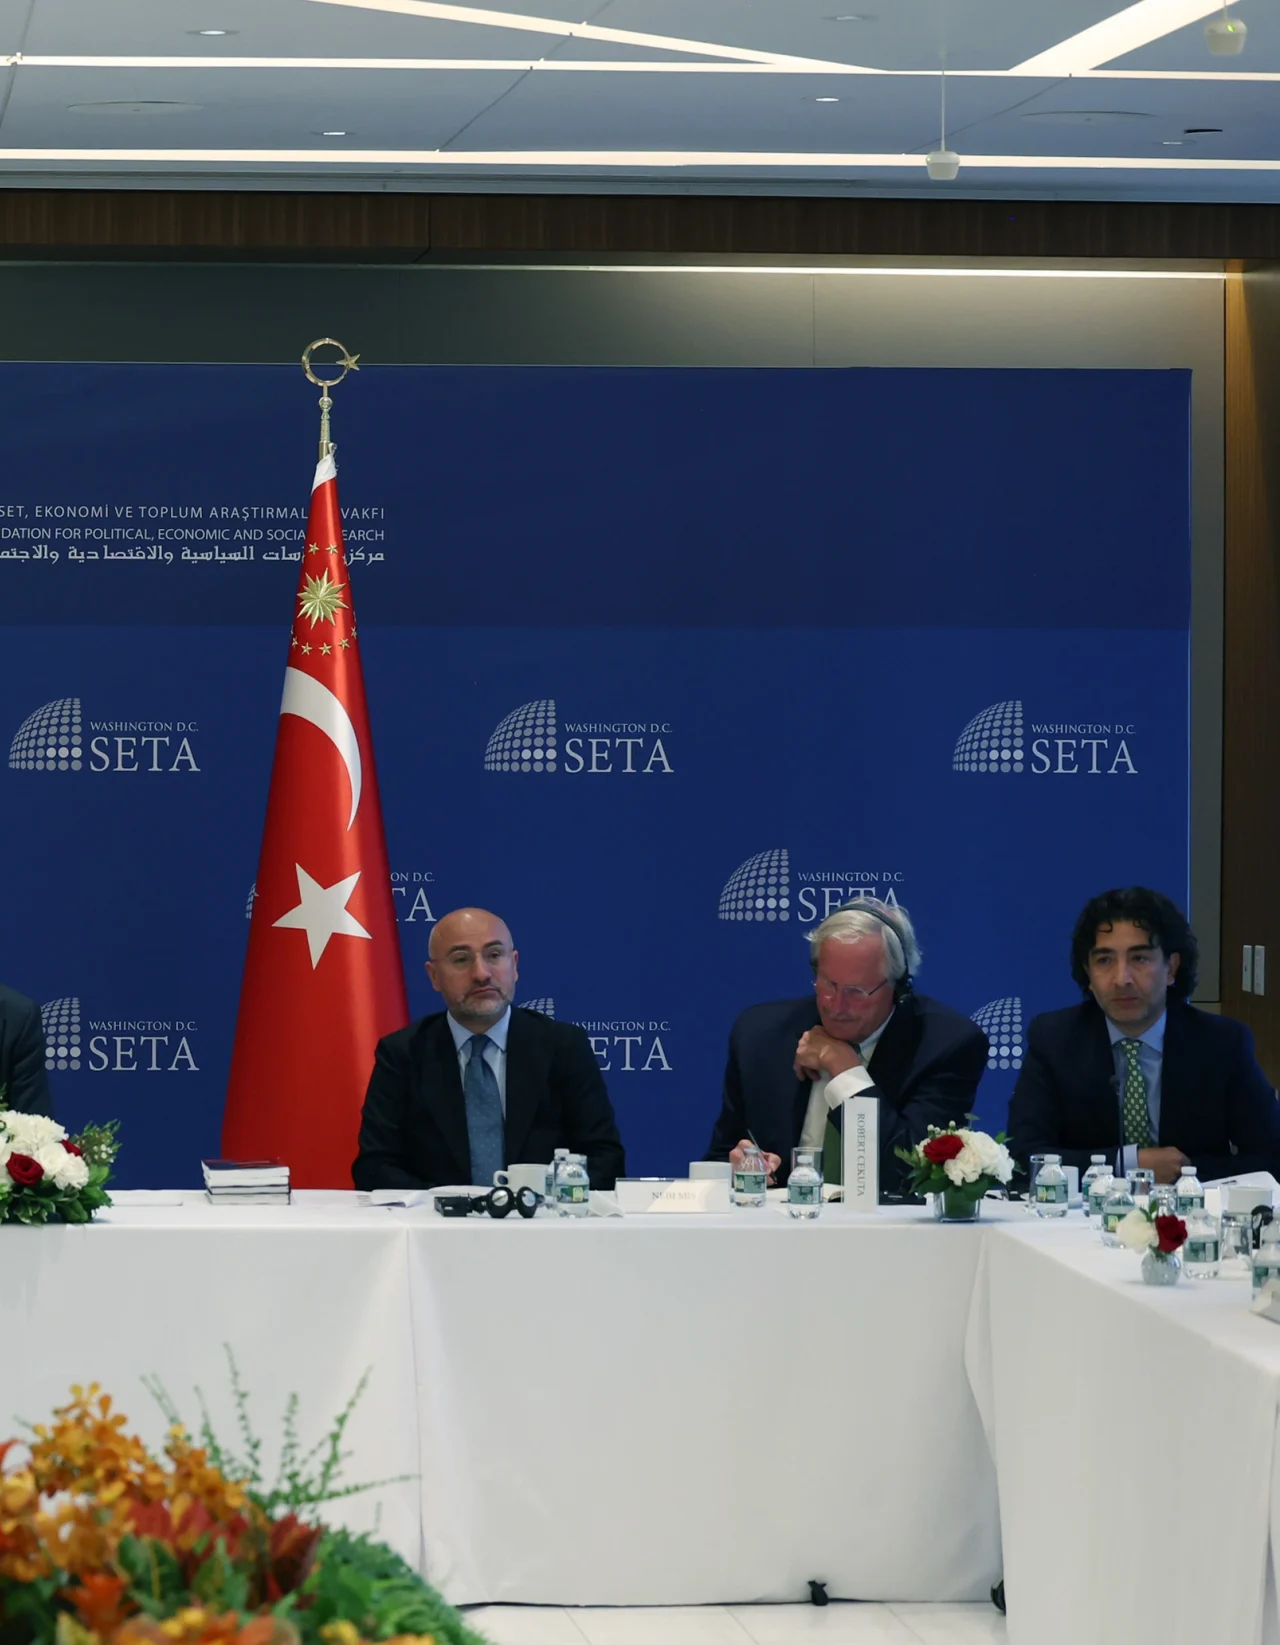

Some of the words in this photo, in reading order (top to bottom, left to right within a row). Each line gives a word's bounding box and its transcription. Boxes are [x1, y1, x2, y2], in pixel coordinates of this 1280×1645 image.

[35, 504, 109, 518] EKONOMİ
[114, 506, 133, 518] VE
[138, 506, 203, 519] TOPLUM
[340, 507, 385, 520] VAKFI
[54, 528, 81, 540] FOR
[84, 528, 155, 541] POLITICAL,
[157, 528, 230, 541] ECONOMIC
[233, 528, 264, 541] AND
[266, 528, 306, 541] SOCIA
[181, 545, 255, 564] السياسية
[89, 721, 173, 732] WASHINGTON
[176, 721, 199, 732] D.C.
[564, 723, 646, 733] WASHINGTON
[650, 723, 673, 733] D.C.
[1031, 724, 1111, 734] WASHINGTON
[1115, 724, 1136, 735] D.C.
[89, 736, 201, 772] SETA
[564, 738, 675, 774] SETA
[1031, 738, 1139, 774] SETA
[413, 871, 435, 882] D.C.
[797, 872, 879, 882] WASHINGTON
[882, 872, 905, 882] D.C.
[88, 1021, 171, 1031] WASHINGTON
[175, 1021, 198, 1031] D.C.
[649, 1021, 671, 1031] D.C.
[88, 1035, 200, 1071] SETA
[588, 1035, 673, 1071] ETA
[856, 1113, 866, 1153] ROBERT
